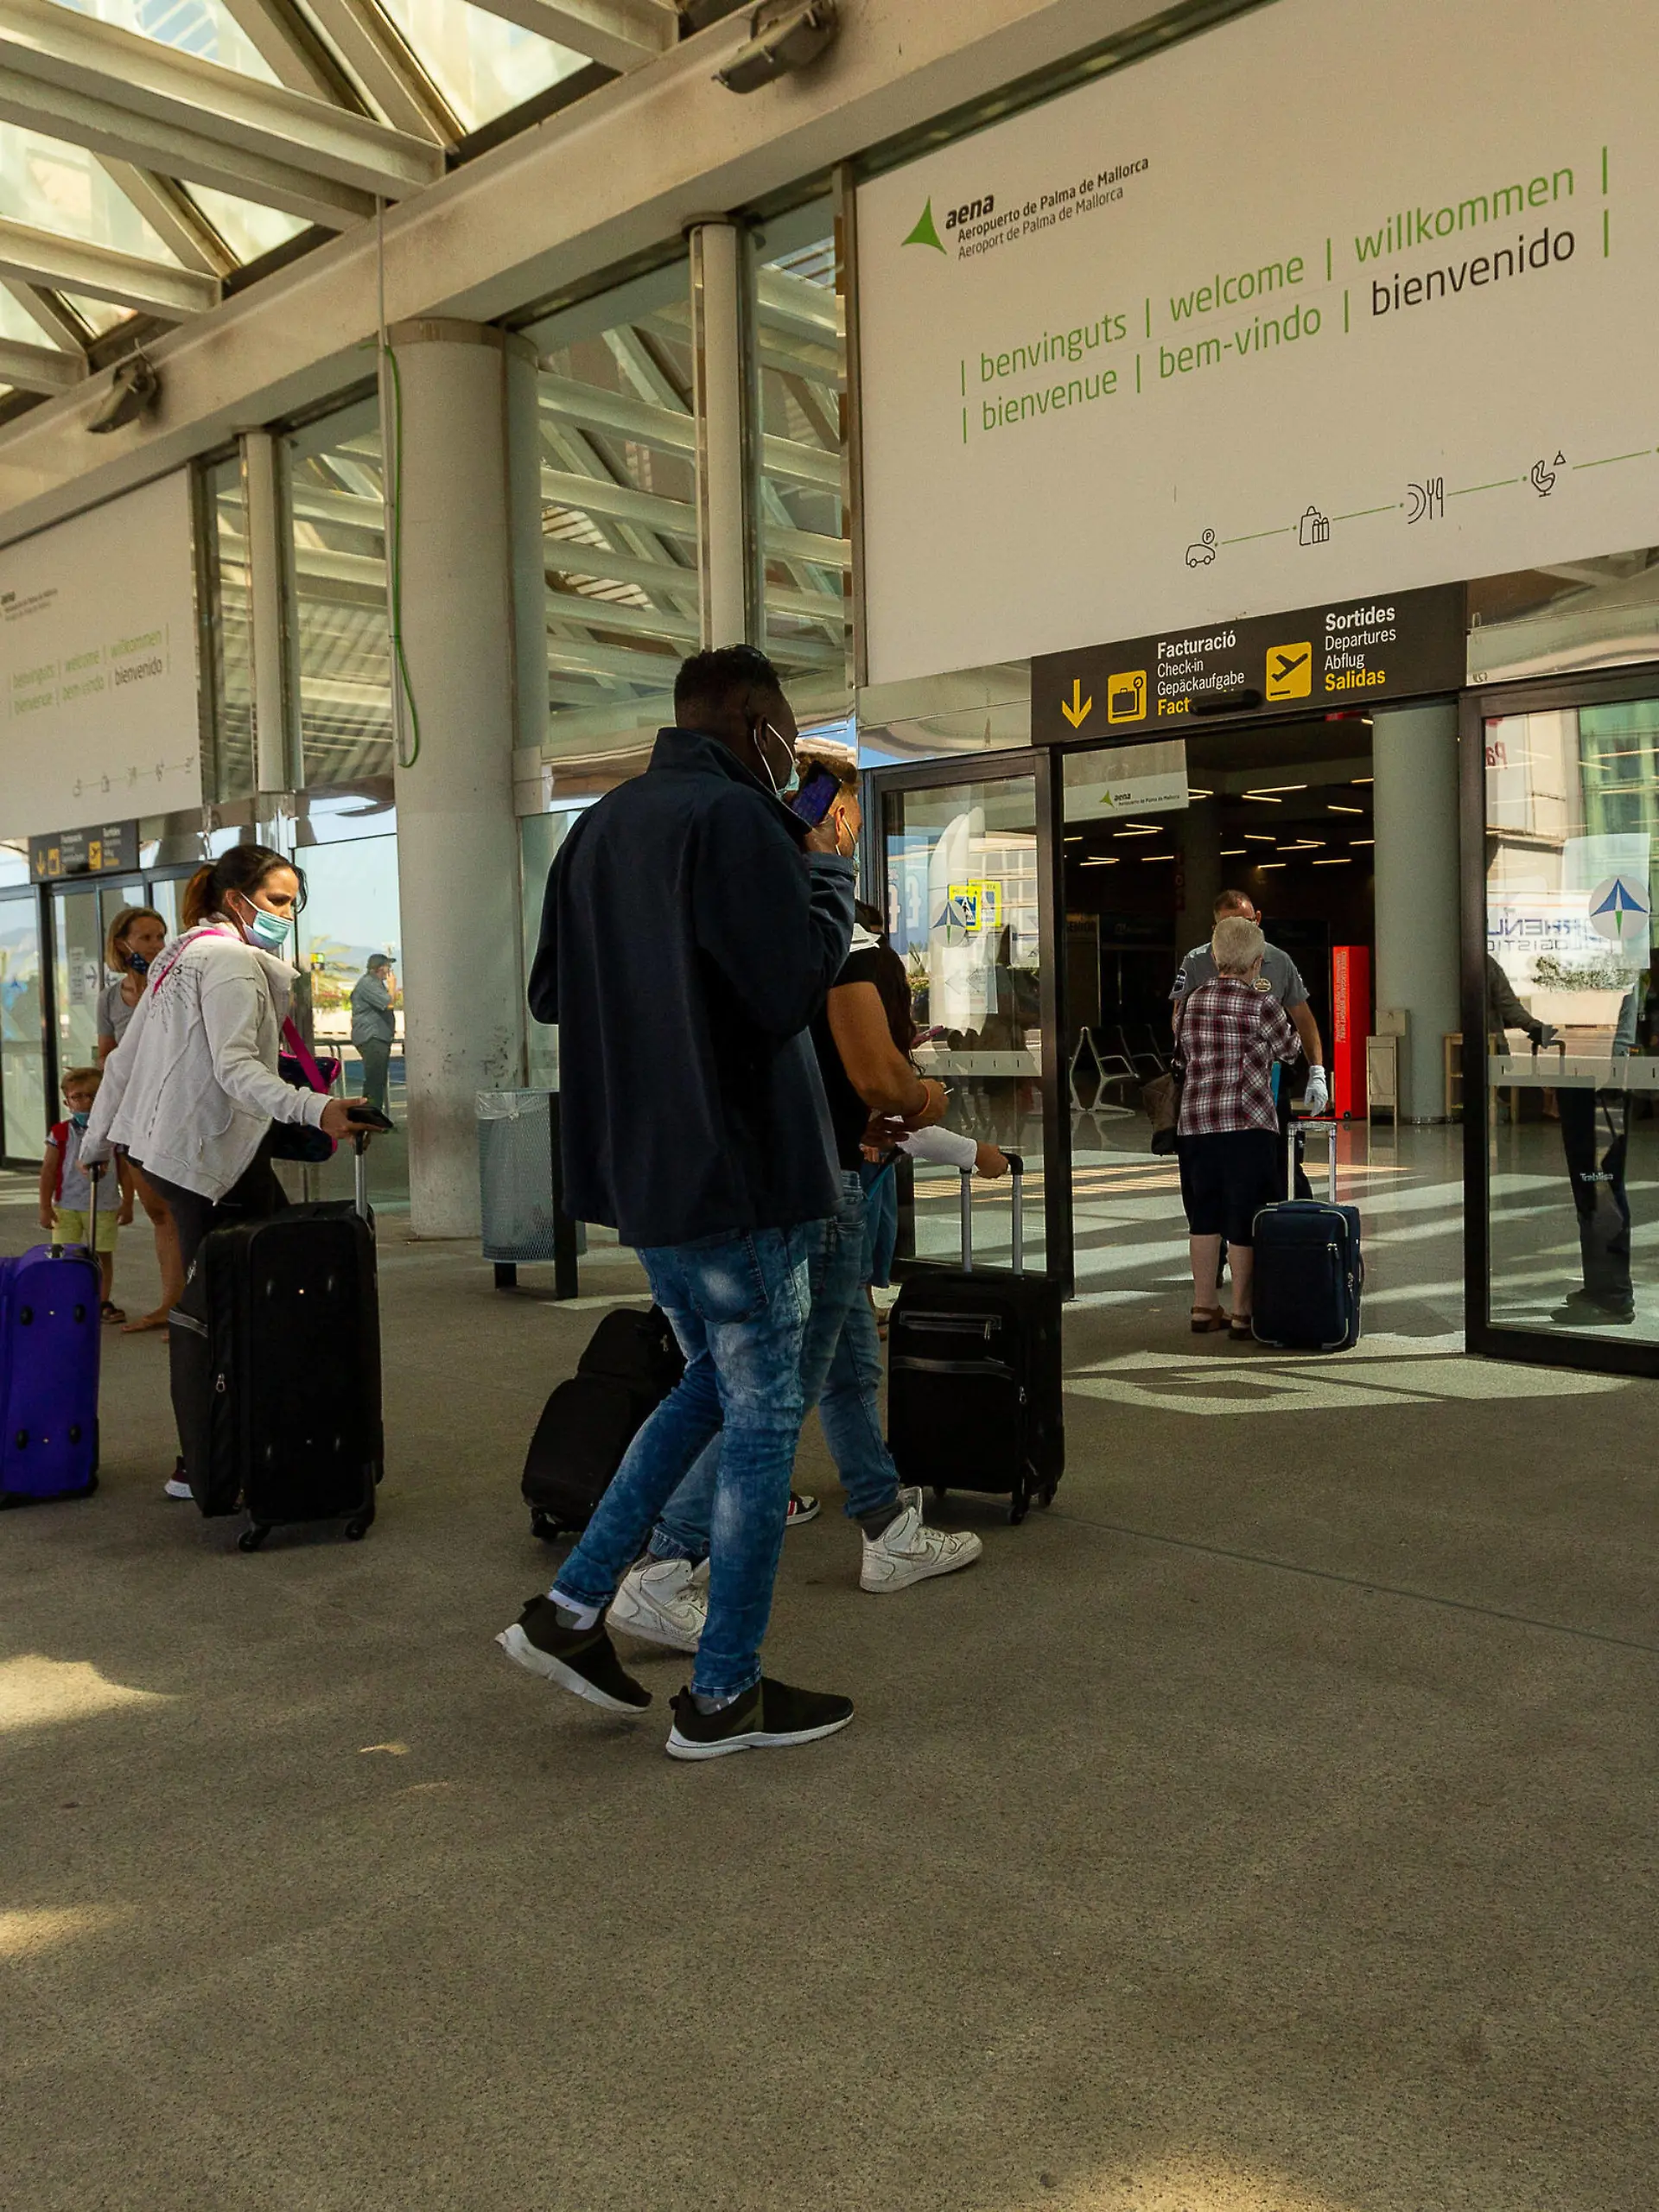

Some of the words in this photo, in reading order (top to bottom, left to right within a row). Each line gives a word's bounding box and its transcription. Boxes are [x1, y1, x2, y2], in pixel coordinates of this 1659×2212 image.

[945, 194, 995, 230] aena
[957, 208, 1020, 243] Aeropuerto
[1022, 200, 1038, 218] de
[1039, 187, 1077, 212] Palma
[1079, 179, 1095, 195] de
[1097, 157, 1149, 188] Mallorca
[958, 234, 1004, 260] Aeroport
[1007, 226, 1020, 241] de
[1022, 214, 1056, 236] Palma
[1058, 207, 1073, 221] de
[1076, 186, 1124, 216] Mallorca
[980, 309, 1128, 384] benvinguts
[1169, 253, 1306, 323] welcome
[1354, 165, 1575, 264] willkommen
[982, 366, 1118, 432] bienvenue
[1159, 302, 1323, 380] bem-vindo
[1371, 225, 1575, 317] bienvenido
[1325, 606, 1395, 632] Sortides
[1158, 630, 1236, 659] Facturació
[1325, 628, 1396, 652] Departures
[114, 657, 163, 686] bienvenido
[1157, 658, 1204, 677] Check-in
[1324, 652, 1365, 671] Abflug
[1157, 671, 1245, 696] Gepäckaufgabe
[1325, 668, 1386, 691] Salidas
